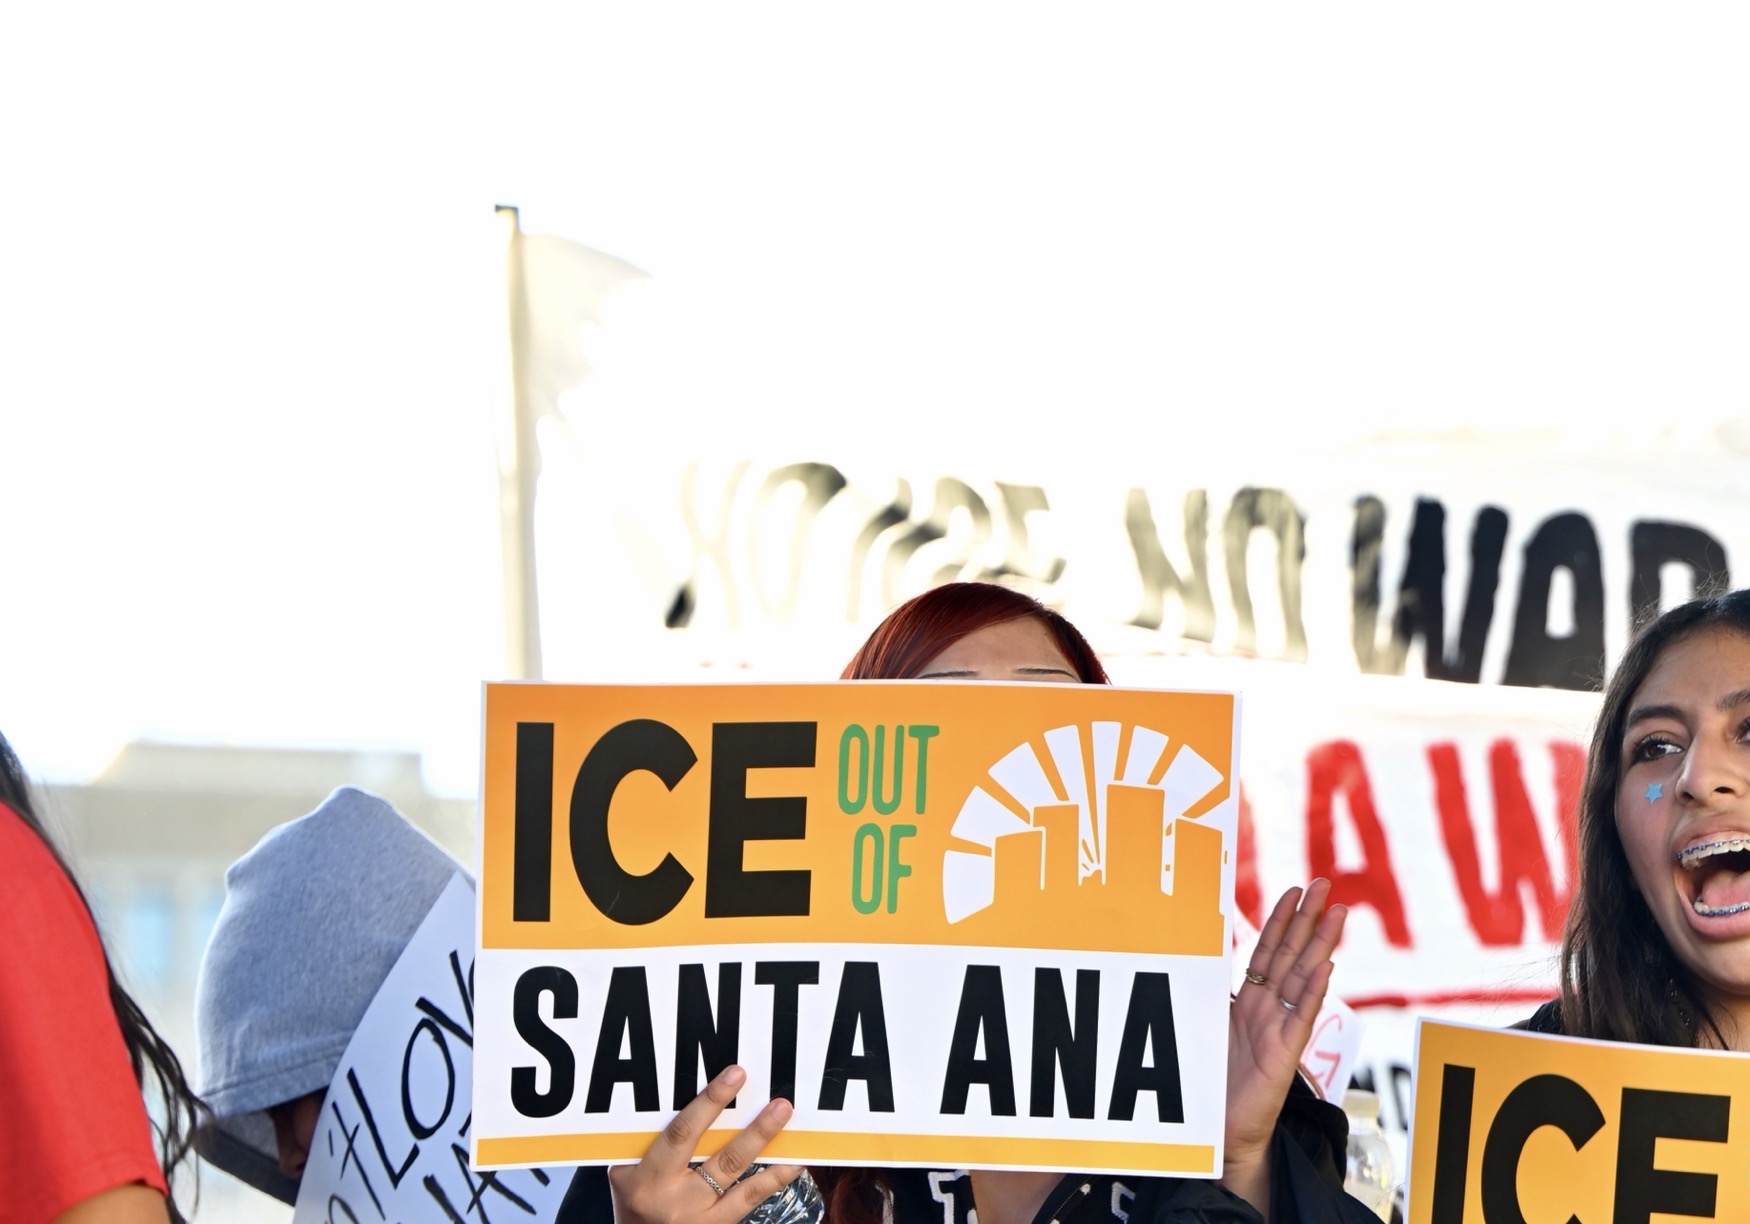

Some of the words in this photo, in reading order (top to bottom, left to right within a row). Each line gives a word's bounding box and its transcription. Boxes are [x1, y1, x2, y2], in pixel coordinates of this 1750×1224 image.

[513, 718, 818, 926] ICE
[838, 724, 940, 815] OUT
[852, 824, 917, 915] OF
[347, 949, 475, 1189] LOV
[510, 960, 895, 1118] SANTA
[939, 964, 1185, 1124] ANA
